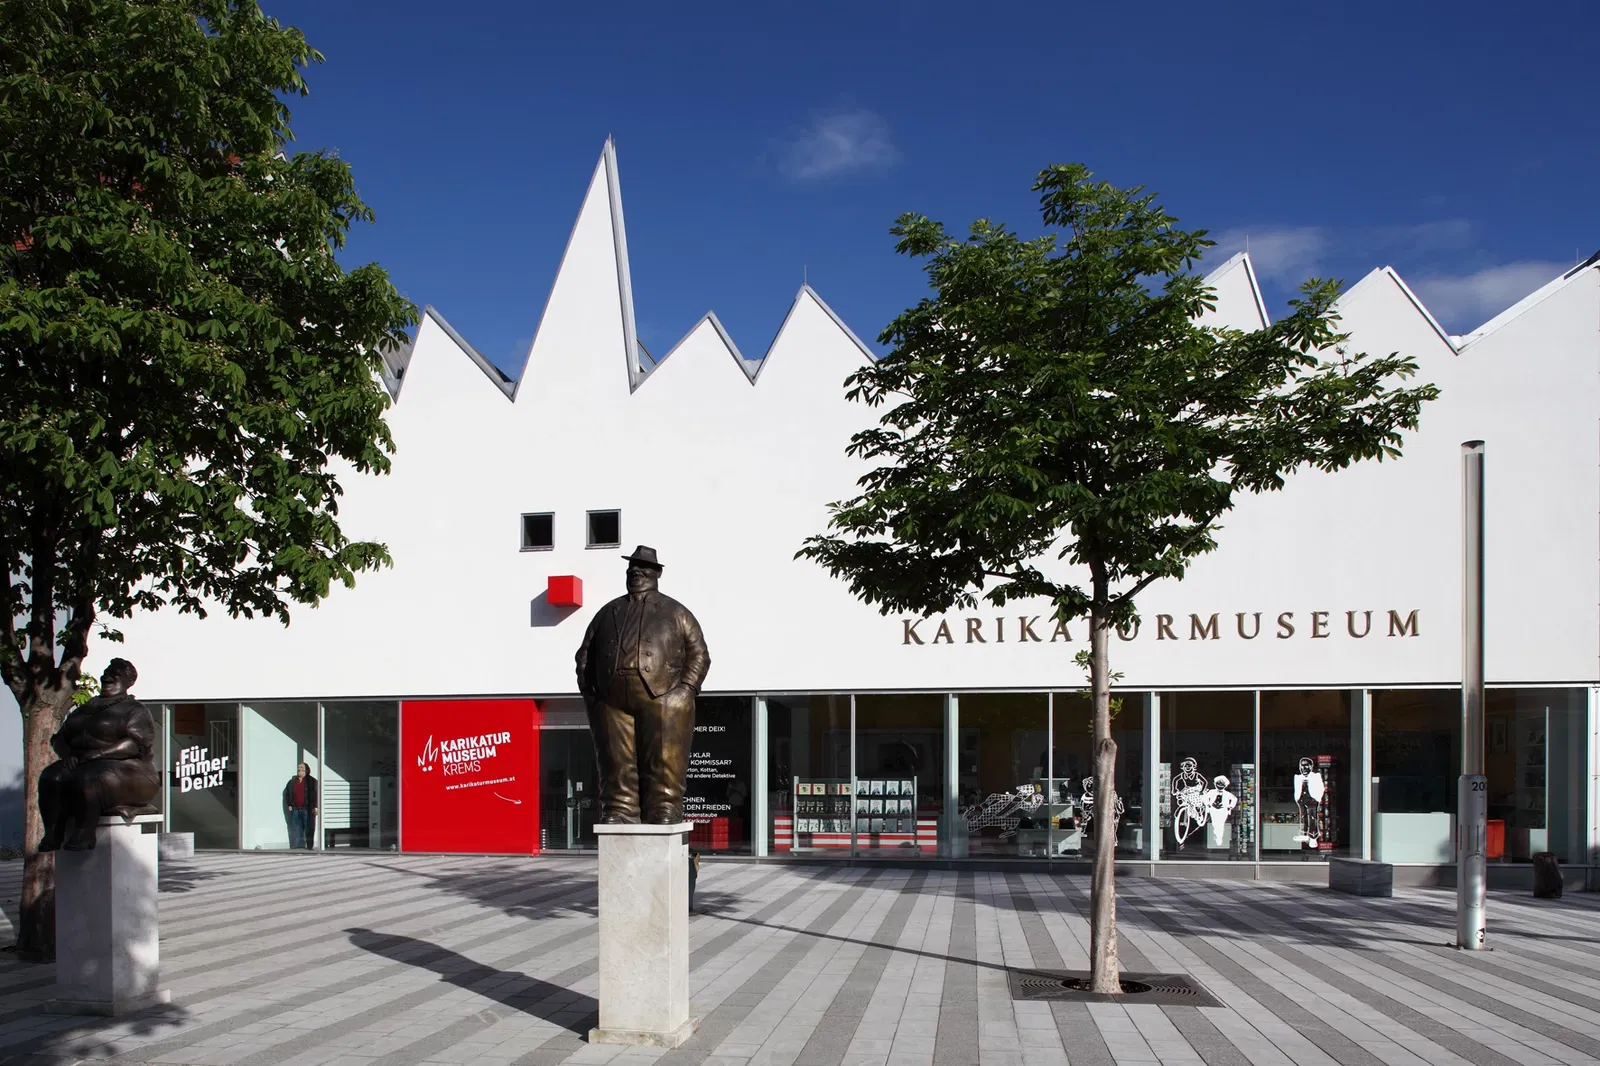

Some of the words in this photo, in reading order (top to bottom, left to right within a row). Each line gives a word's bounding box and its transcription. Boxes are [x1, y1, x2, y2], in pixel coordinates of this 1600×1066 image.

[440, 731, 511, 753] KARIKATUR
[181, 745, 208, 765] Für
[442, 746, 497, 764] MUSEUM
[175, 756, 229, 779] immer
[443, 760, 481, 776] KREMS
[181, 770, 223, 793] Deix!
[446, 776, 515, 790] www.karikaturmuseum.at
[1471, 781, 1487, 791] 20
